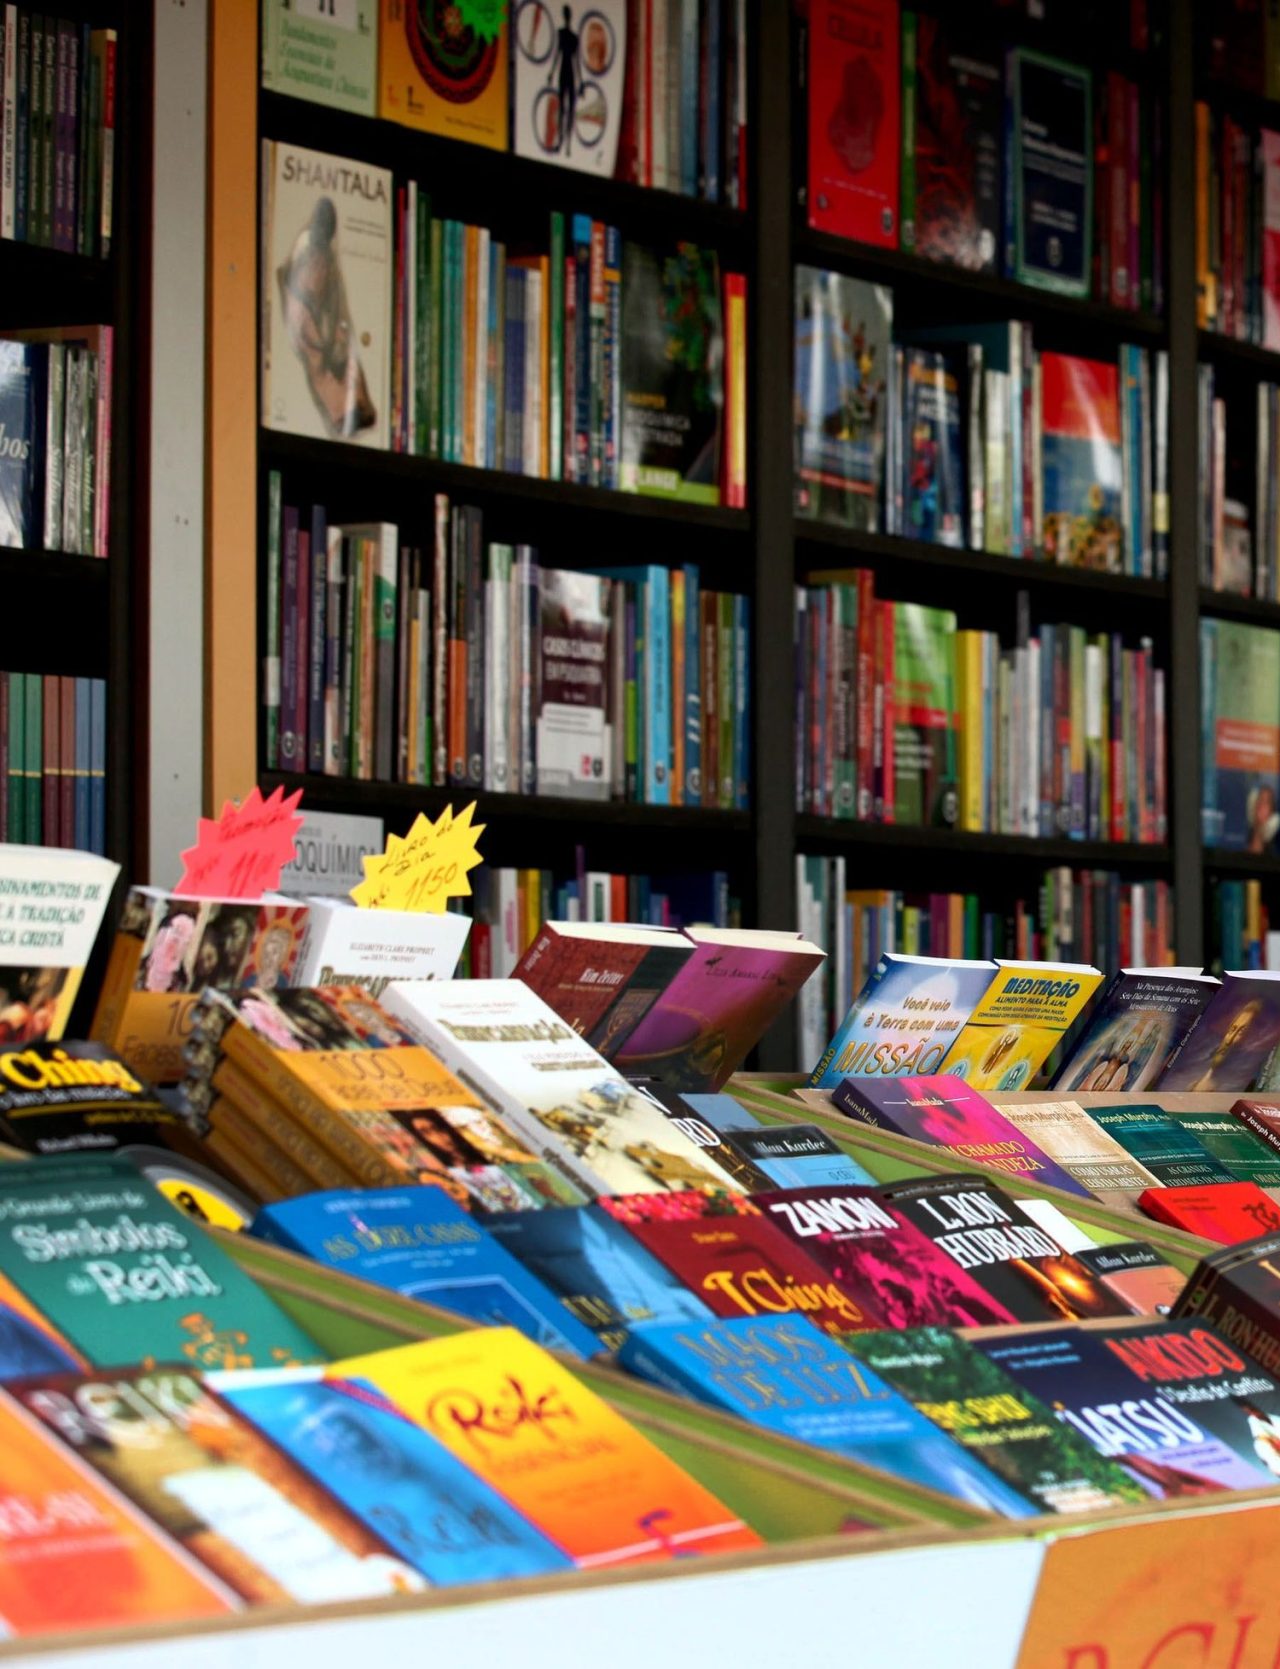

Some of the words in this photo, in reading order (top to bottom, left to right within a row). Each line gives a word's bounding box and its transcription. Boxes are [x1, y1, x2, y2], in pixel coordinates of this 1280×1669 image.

[282, 155, 388, 205] SHANTALA
[638, 468, 678, 492] LANGE
[20, 903, 86, 924] TRADIÇÃO
[19, 928, 65, 948] CRISTÃ
[580, 967, 600, 983] Kim
[1002, 976, 1081, 1000] MEDITAÇÃO
[903, 996, 930, 1012] Você
[929, 998, 951, 1012] veio
[995, 996, 1026, 1005] ALIMENTO
[1026, 997, 1042, 1005] PARA
[1050, 999, 1068, 1008] ALMA
[864, 1013, 873, 1028] à
[874, 1012, 907, 1031] Terra
[906, 1019, 935, 1031] com
[934, 1020, 961, 1032] uma
[810, 1047, 836, 1086] MISSÃO
[832, 1037, 946, 1076] MISSÃO
[1097, 1114, 1123, 1125] Joseph
[1180, 1120, 1203, 1131] Joseph
[1247, 1115, 1269, 1138] Joseph
[784, 1138, 827, 1153] Kardec
[959, 1140, 1026, 1158] CHAMADO
[1070, 1165, 1095, 1177] COMO
[1120, 1164, 1136, 1175] AS
[1114, 1175, 1149, 1188] MENTE
[769, 1196, 900, 1238] ZANONI
[953, 1191, 1013, 1227] RON
[933, 1226, 1063, 1271] HUBBARD
[1122, 1251, 1158, 1267] Kardec
[86, 1251, 223, 1306] Reiki
[1216, 1305, 1251, 1351] RON
[1104, 1328, 1247, 1383] AIKIDO
[1055, 1398, 1205, 1457] IATSU
